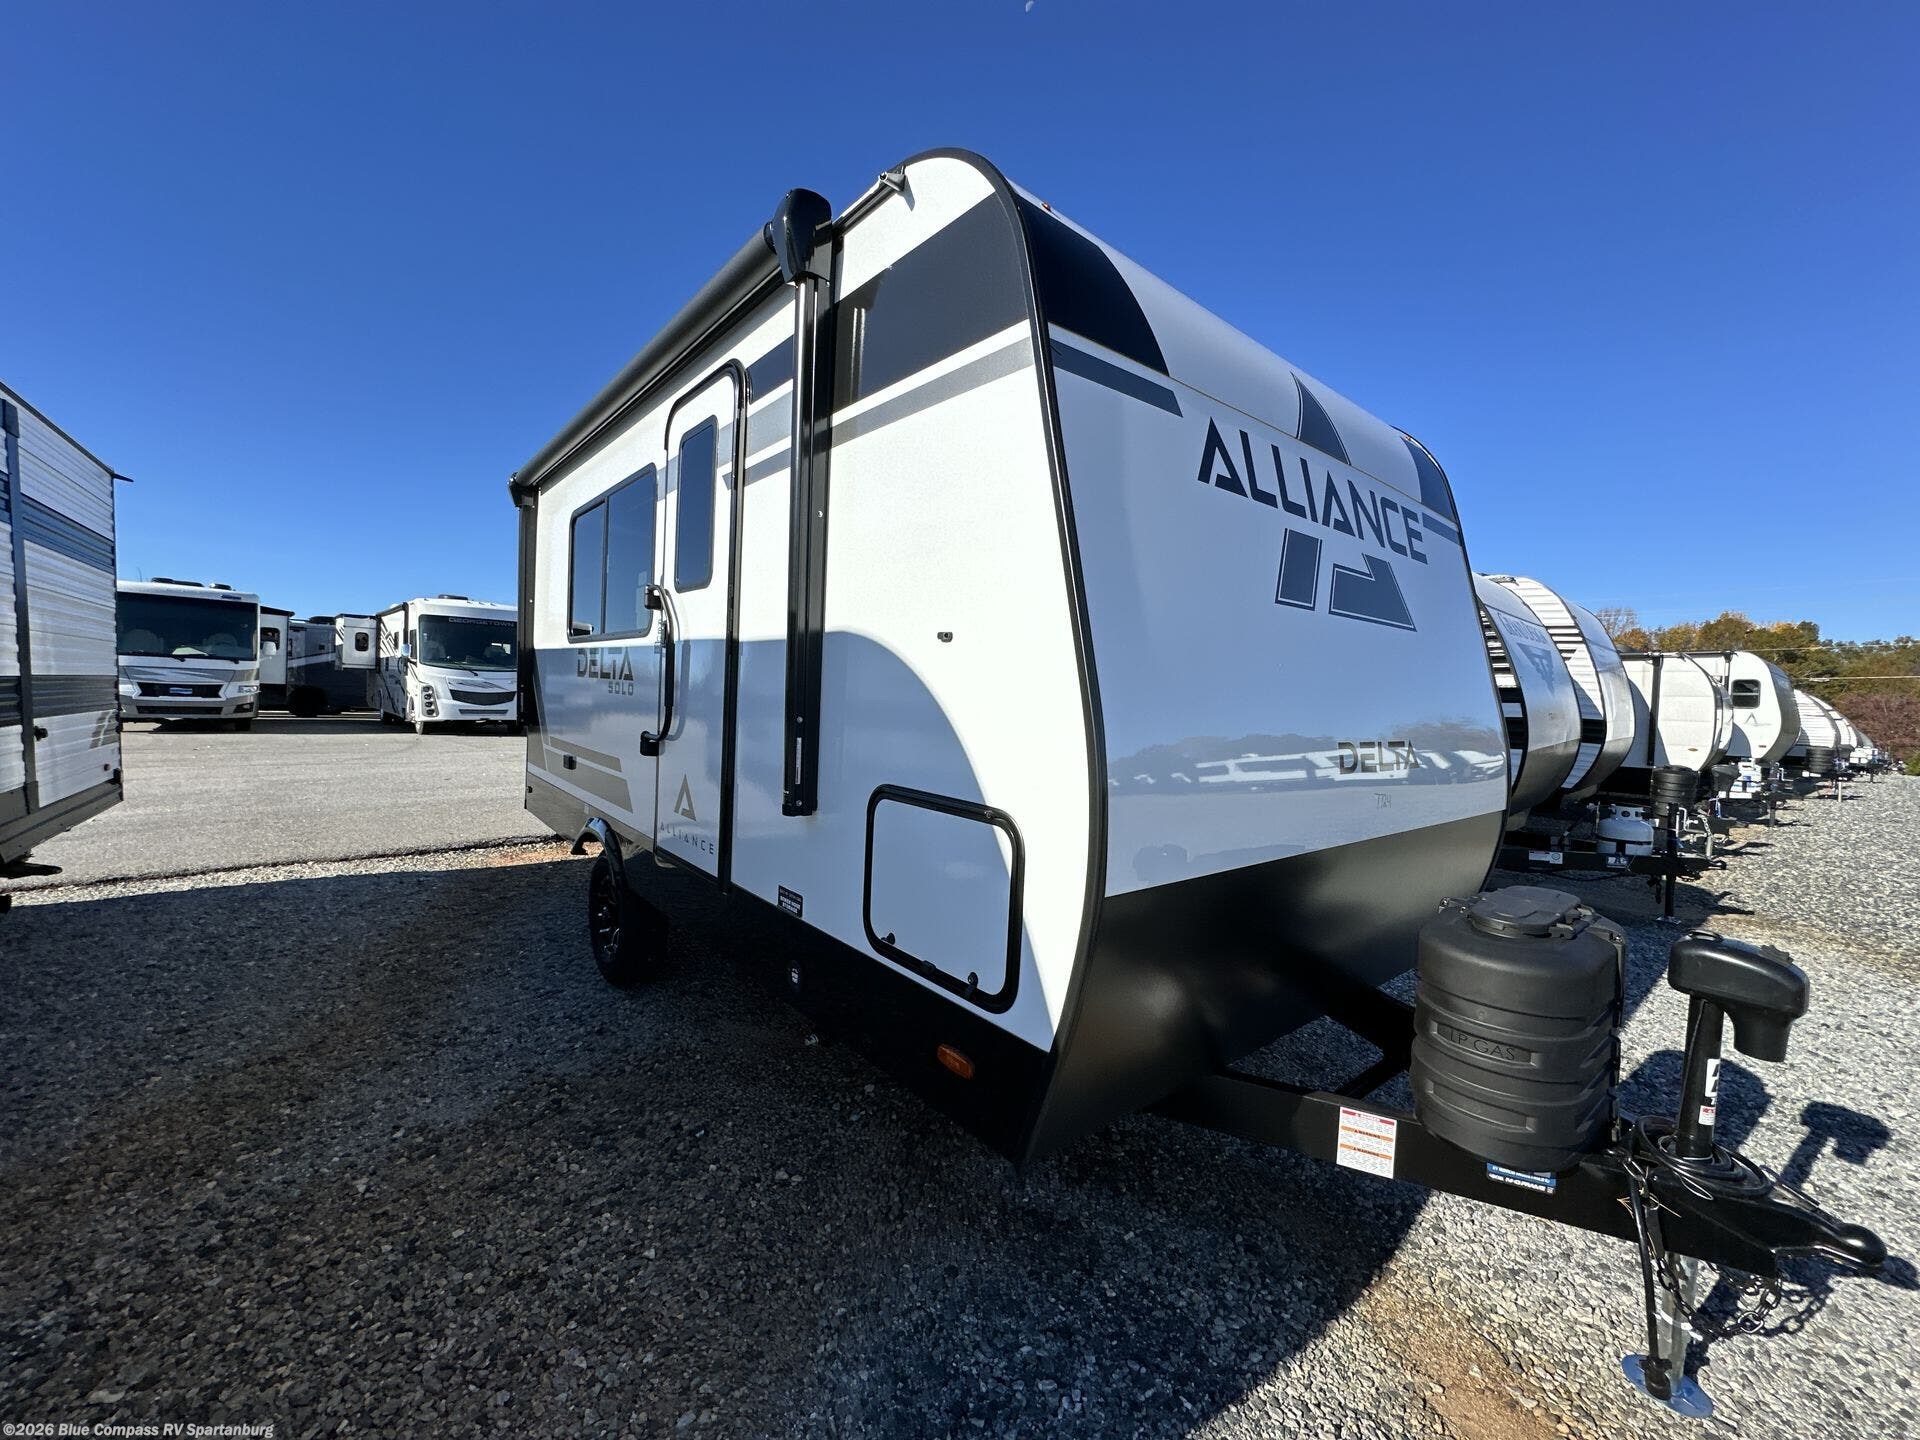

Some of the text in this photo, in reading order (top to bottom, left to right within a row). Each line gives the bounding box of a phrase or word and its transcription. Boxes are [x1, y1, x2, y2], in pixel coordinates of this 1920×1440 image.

[1197, 416, 1428, 565] ALLIANCE
[577, 647, 635, 682] DELTA
[607, 681, 634, 697] SOLO
[1338, 740, 1421, 775] DELTA
[659, 820, 715, 856] ALLIANCE
[1473, 1040, 1515, 1061] GAS
